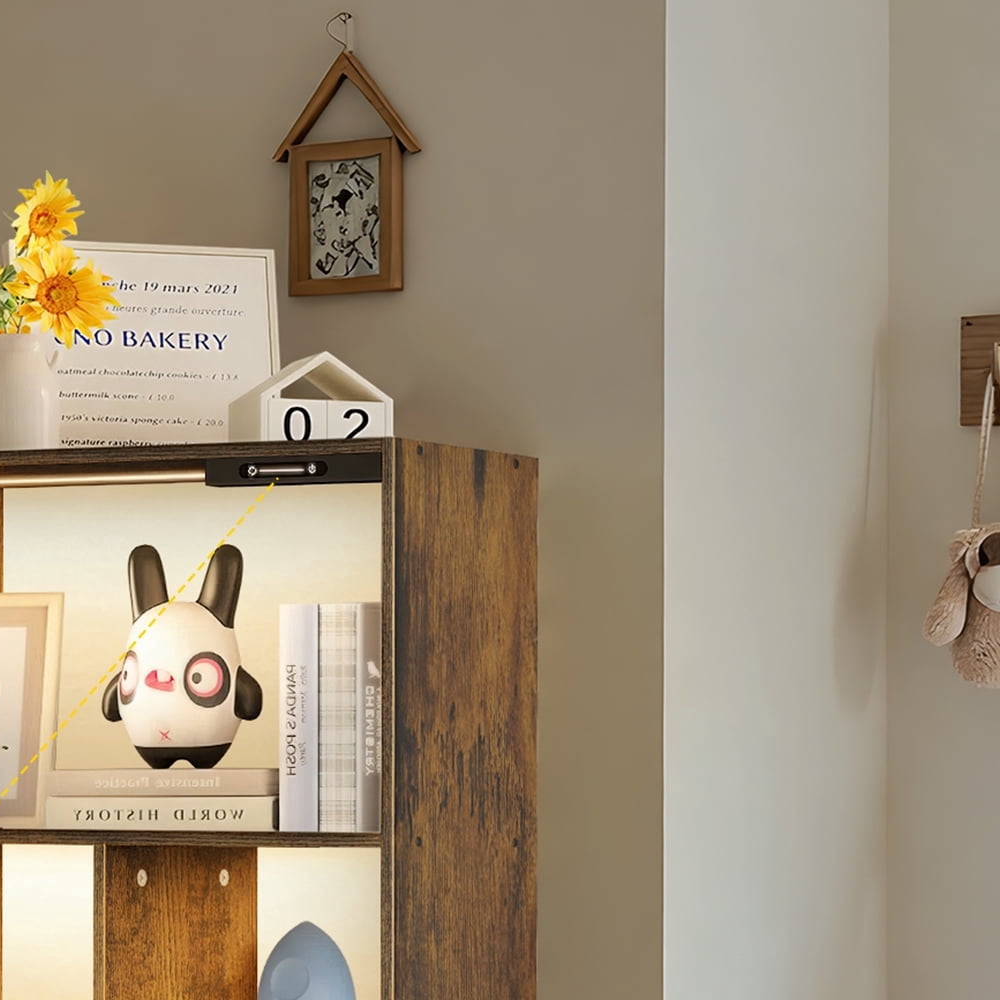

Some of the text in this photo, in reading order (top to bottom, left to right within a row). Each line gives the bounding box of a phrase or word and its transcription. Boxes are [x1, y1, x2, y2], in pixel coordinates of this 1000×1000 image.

[144, 282, 159, 292] 19
[162, 283, 200, 294] mars
[204, 284, 238, 295] 2021
[151, 305, 187, 316] grande
[123, 330, 228, 351] BAKERY
[57, 368, 97, 376] oatmeal
[166, 371, 203, 380] cookies
[59, 391, 110, 400] buttermilk
[92, 415, 128, 423] victoria
[131, 416, 162, 426] sponge
[166, 417, 189, 425] cake
[61, 436, 106, 447] signature
